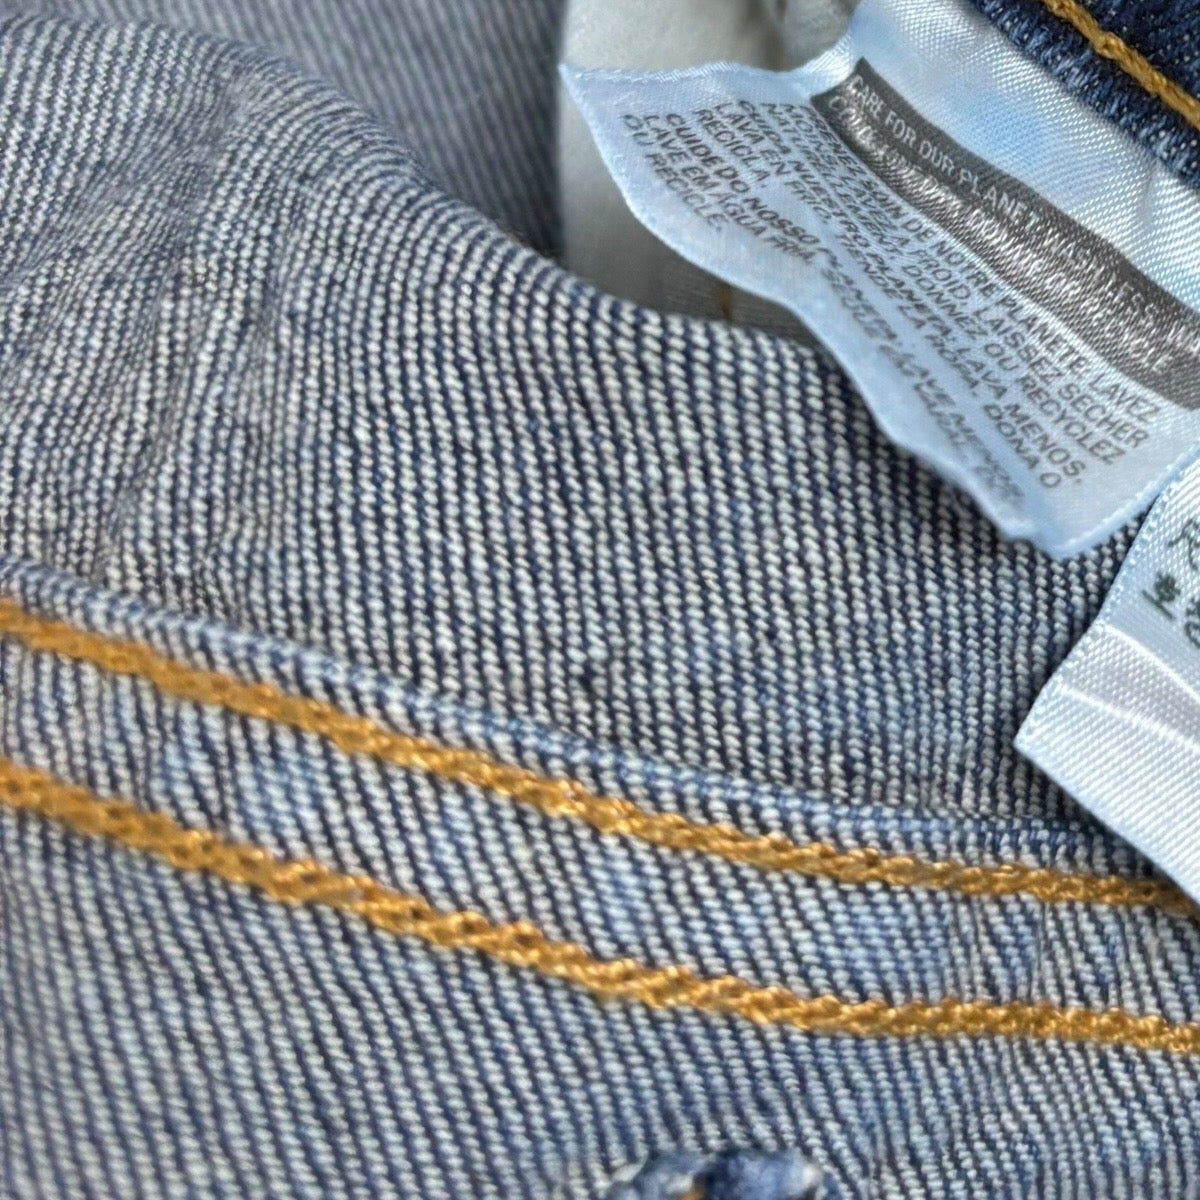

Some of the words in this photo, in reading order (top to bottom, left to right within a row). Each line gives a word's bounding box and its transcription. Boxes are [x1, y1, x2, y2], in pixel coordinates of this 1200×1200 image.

[620, 115, 656, 147] OU
[641, 116, 690, 163] LAVE
[680, 162, 723, 192] EM
[845, 74, 887, 119] CARE
[882, 108, 920, 148] FOR
[917, 138, 957, 177] OUR
[1044, 226, 1106, 280] WASH
[741, 194, 822, 245] NOSSO
[713, 102, 766, 147] LAVA
[758, 145, 792, 178] EN
[896, 306, 928, 331] LA
[981, 402, 1041, 471] DONA
[1039, 470, 1062, 489] O
[858, 177, 907, 220] SOIN
[900, 217, 935, 244] DE
[929, 239, 1001, 298] NOTRE
[1087, 372, 1161, 425] LAVEZ
[1043, 268, 1083, 304] OR
[900, 263, 989, 340] DONNEZ
[981, 340, 1021, 373] OU
[1014, 374, 1126, 467] RECYCLEZ
[955, 348, 1009, 400] LAVA
[971, 307, 1065, 387] LAISSEZ
[1056, 381, 1150, 450] SECHER
